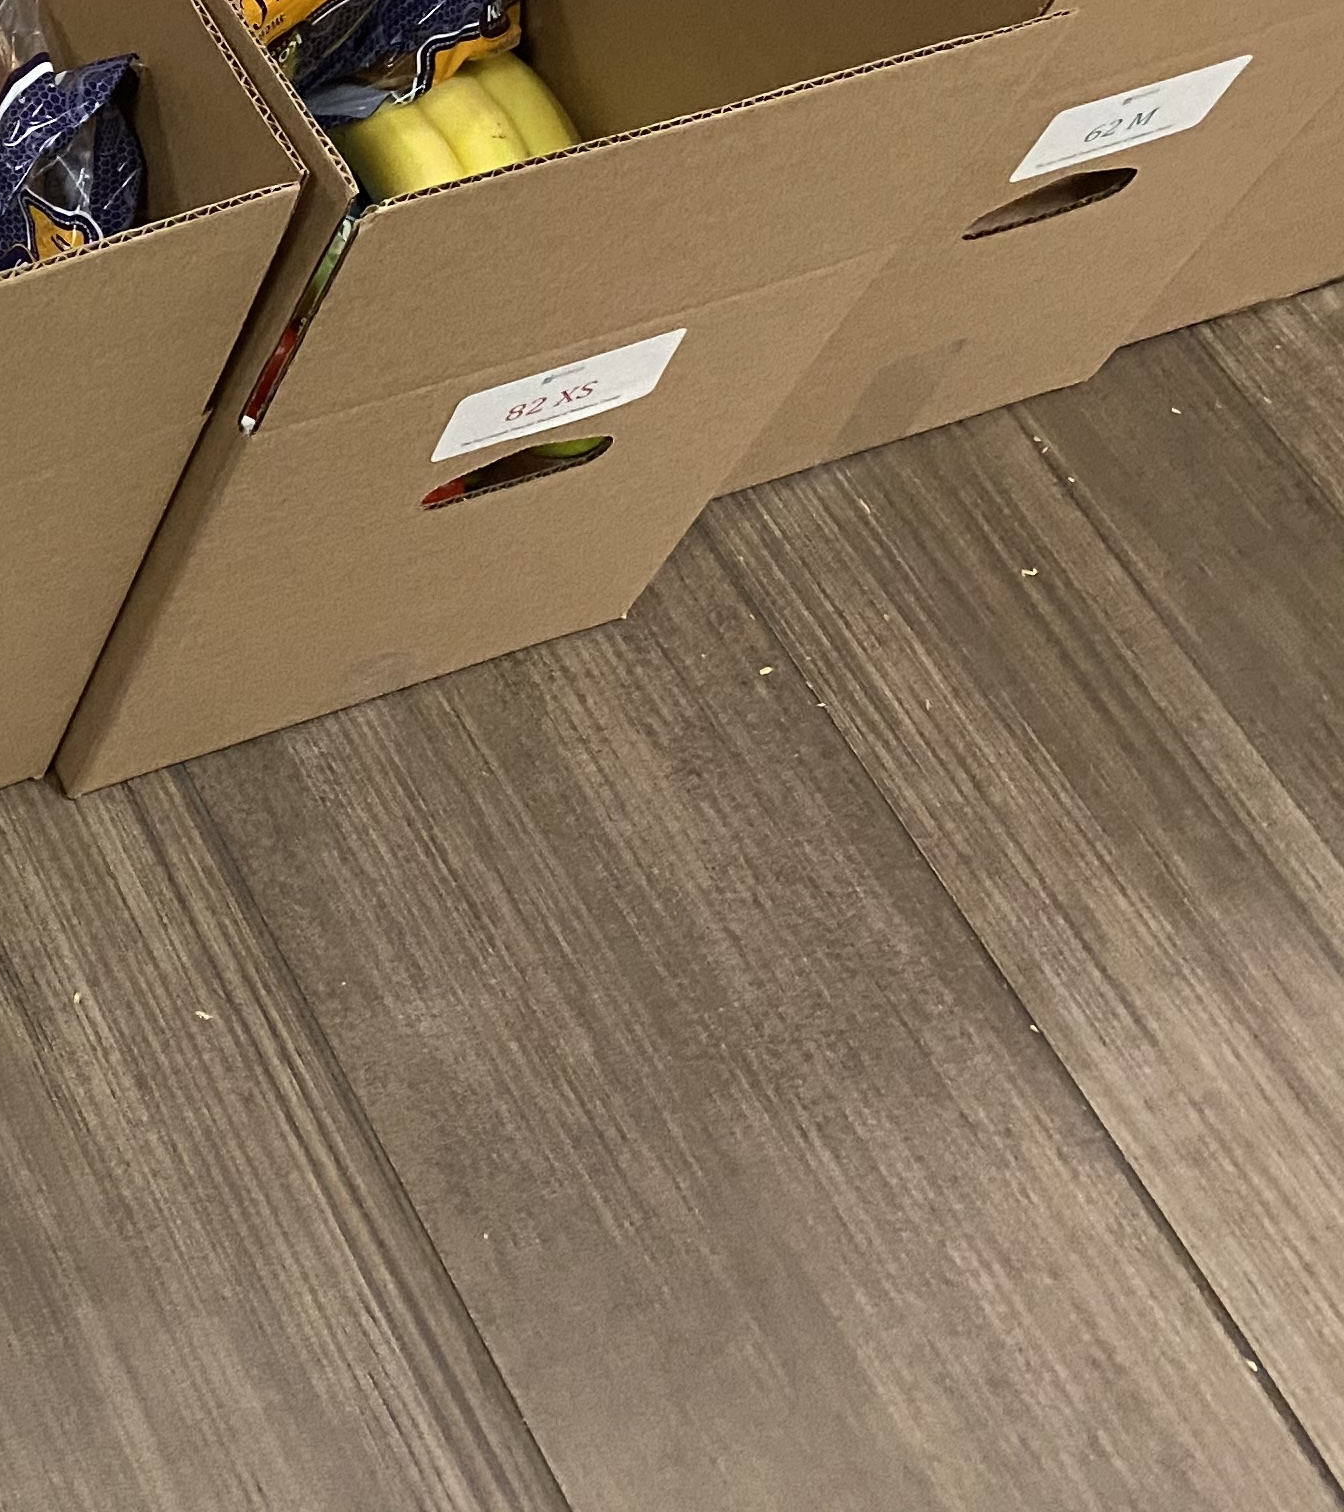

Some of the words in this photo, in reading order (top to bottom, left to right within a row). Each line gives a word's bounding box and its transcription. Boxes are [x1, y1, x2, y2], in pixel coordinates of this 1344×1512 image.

[1084, 118, 1124, 142] 62
[1126, 107, 1160, 130] M
[505, 396, 548, 422] 82
[553, 380, 599, 407] XS
